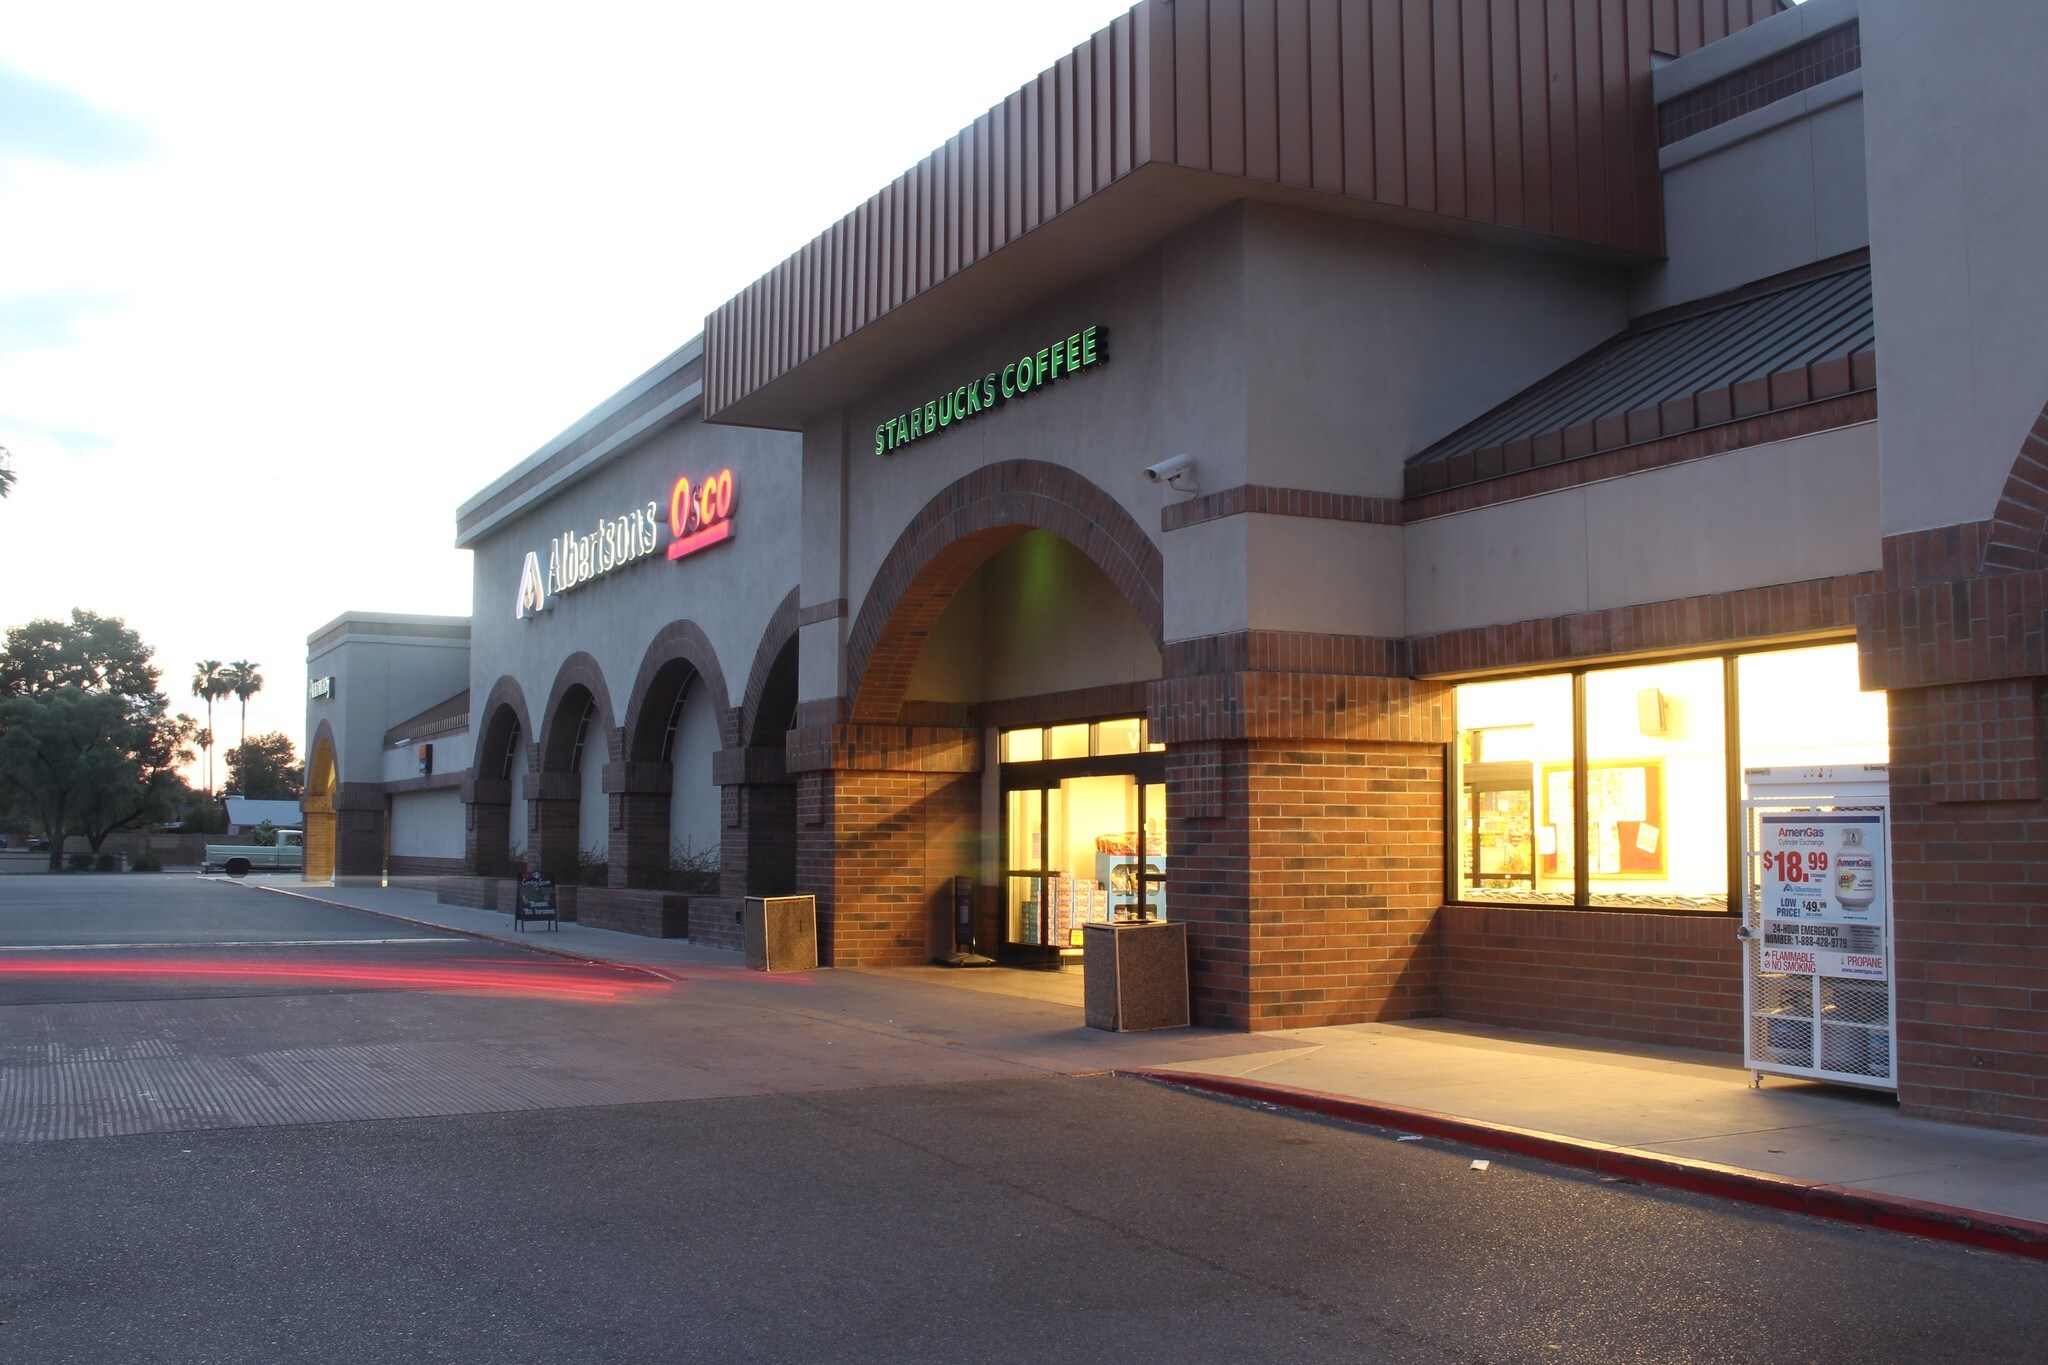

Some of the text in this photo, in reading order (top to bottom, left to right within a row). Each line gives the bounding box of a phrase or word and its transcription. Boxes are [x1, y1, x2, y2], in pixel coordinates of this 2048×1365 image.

[875, 325, 1097, 456] STARBUCKS COFFEE
[671, 468, 733, 538] Osco
[547, 501, 657, 596] Albertsons
[1778, 827, 1824, 837] AmeriGas
[1799, 839, 1824, 847] Exchange
[1763, 849, 1828, 882] $18.99
[1837, 859, 1872, 867] AmeriGas
[1781, 898, 1797, 908] LOW
[1801, 900, 1827, 912] $49.99
[1776, 907, 1801, 918] PRICE!
[1772, 923, 1839, 937] 24-HOUR EMERGENCY
[1765, 934, 1793, 945] NUMBER:
[1771, 951, 1814, 962] FLAMMABLE
[1847, 956, 1882, 968] PROPANE
[1771, 961, 1816, 973] NO SMOKING
